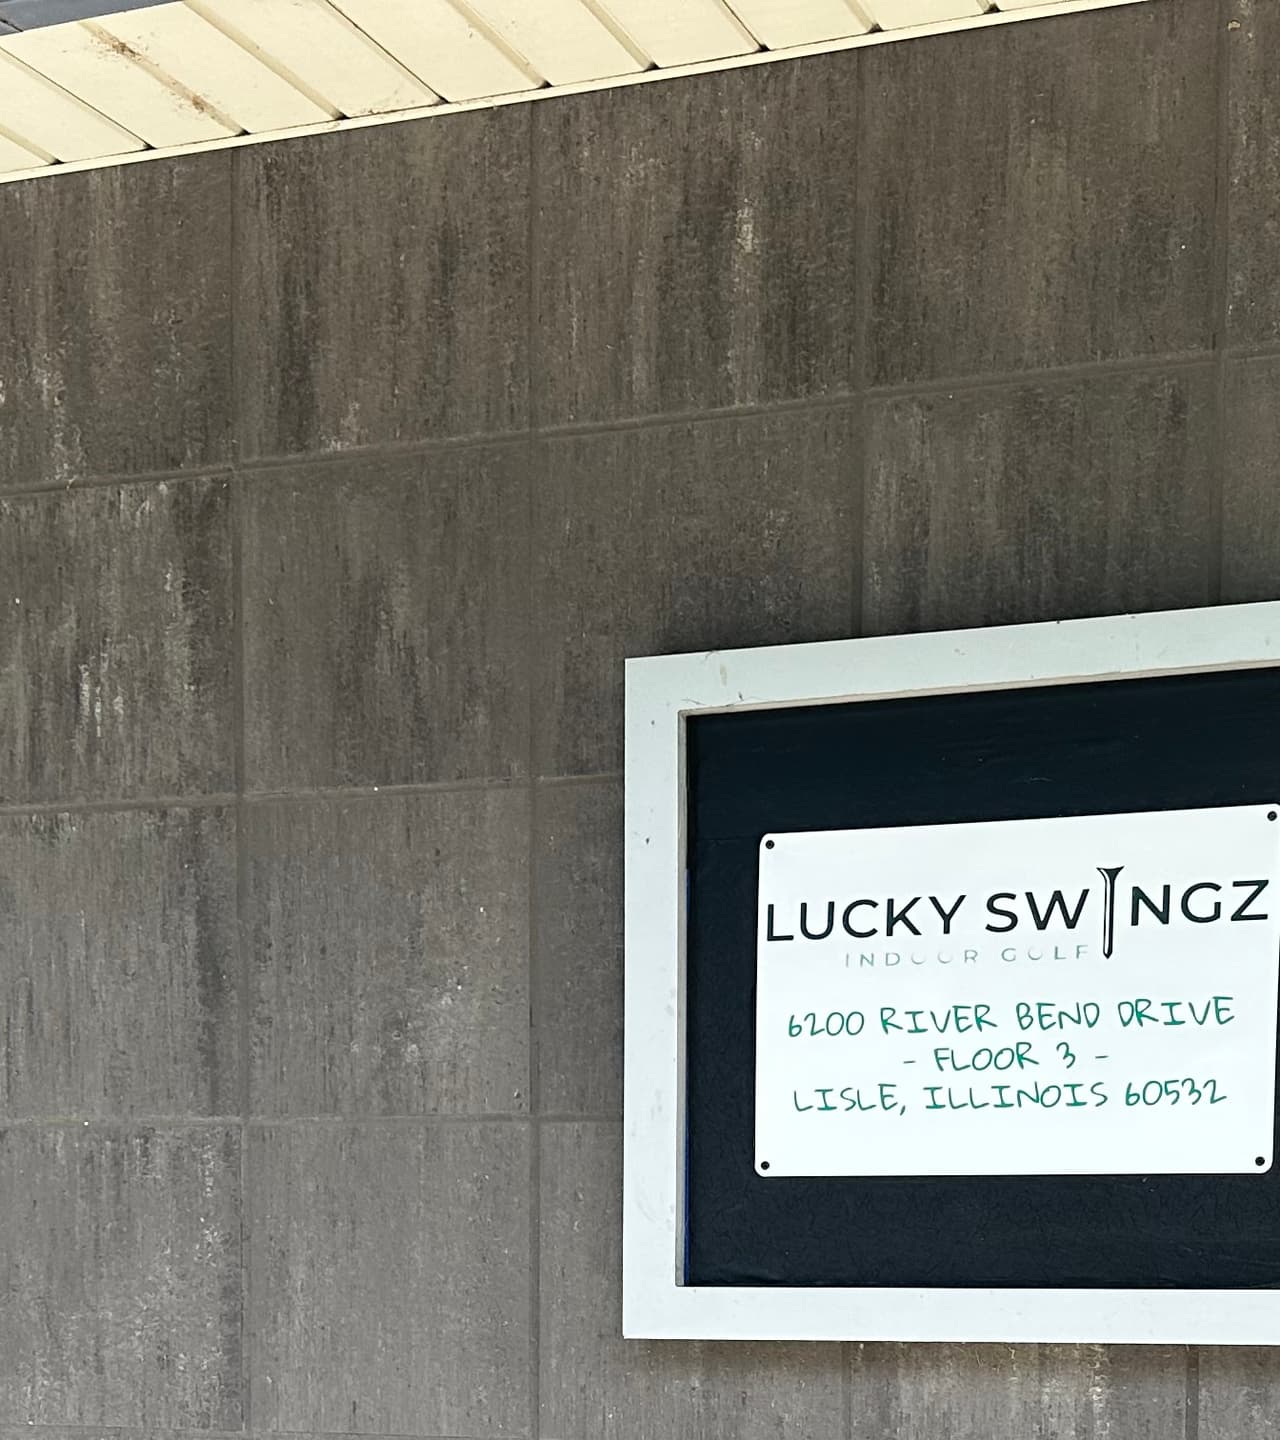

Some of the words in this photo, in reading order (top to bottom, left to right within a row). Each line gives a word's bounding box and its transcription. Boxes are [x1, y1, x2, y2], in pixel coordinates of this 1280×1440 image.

[766, 894, 967, 942] LUCKY
[985, 866, 1269, 960] SWINGZ
[788, 1010, 865, 1038] 6200
[880, 1003, 998, 1035] RIVER
[1016, 1001, 1101, 1032] BEND
[1118, 995, 1236, 1028] DRIVE
[934, 1041, 1040, 1072] FLOOR
[1056, 1041, 1077, 1070] 3
[794, 1083, 906, 1117] LISLE,
[923, 1080, 1109, 1110] ILLINOIS
[1125, 1077, 1228, 1107] 60532
